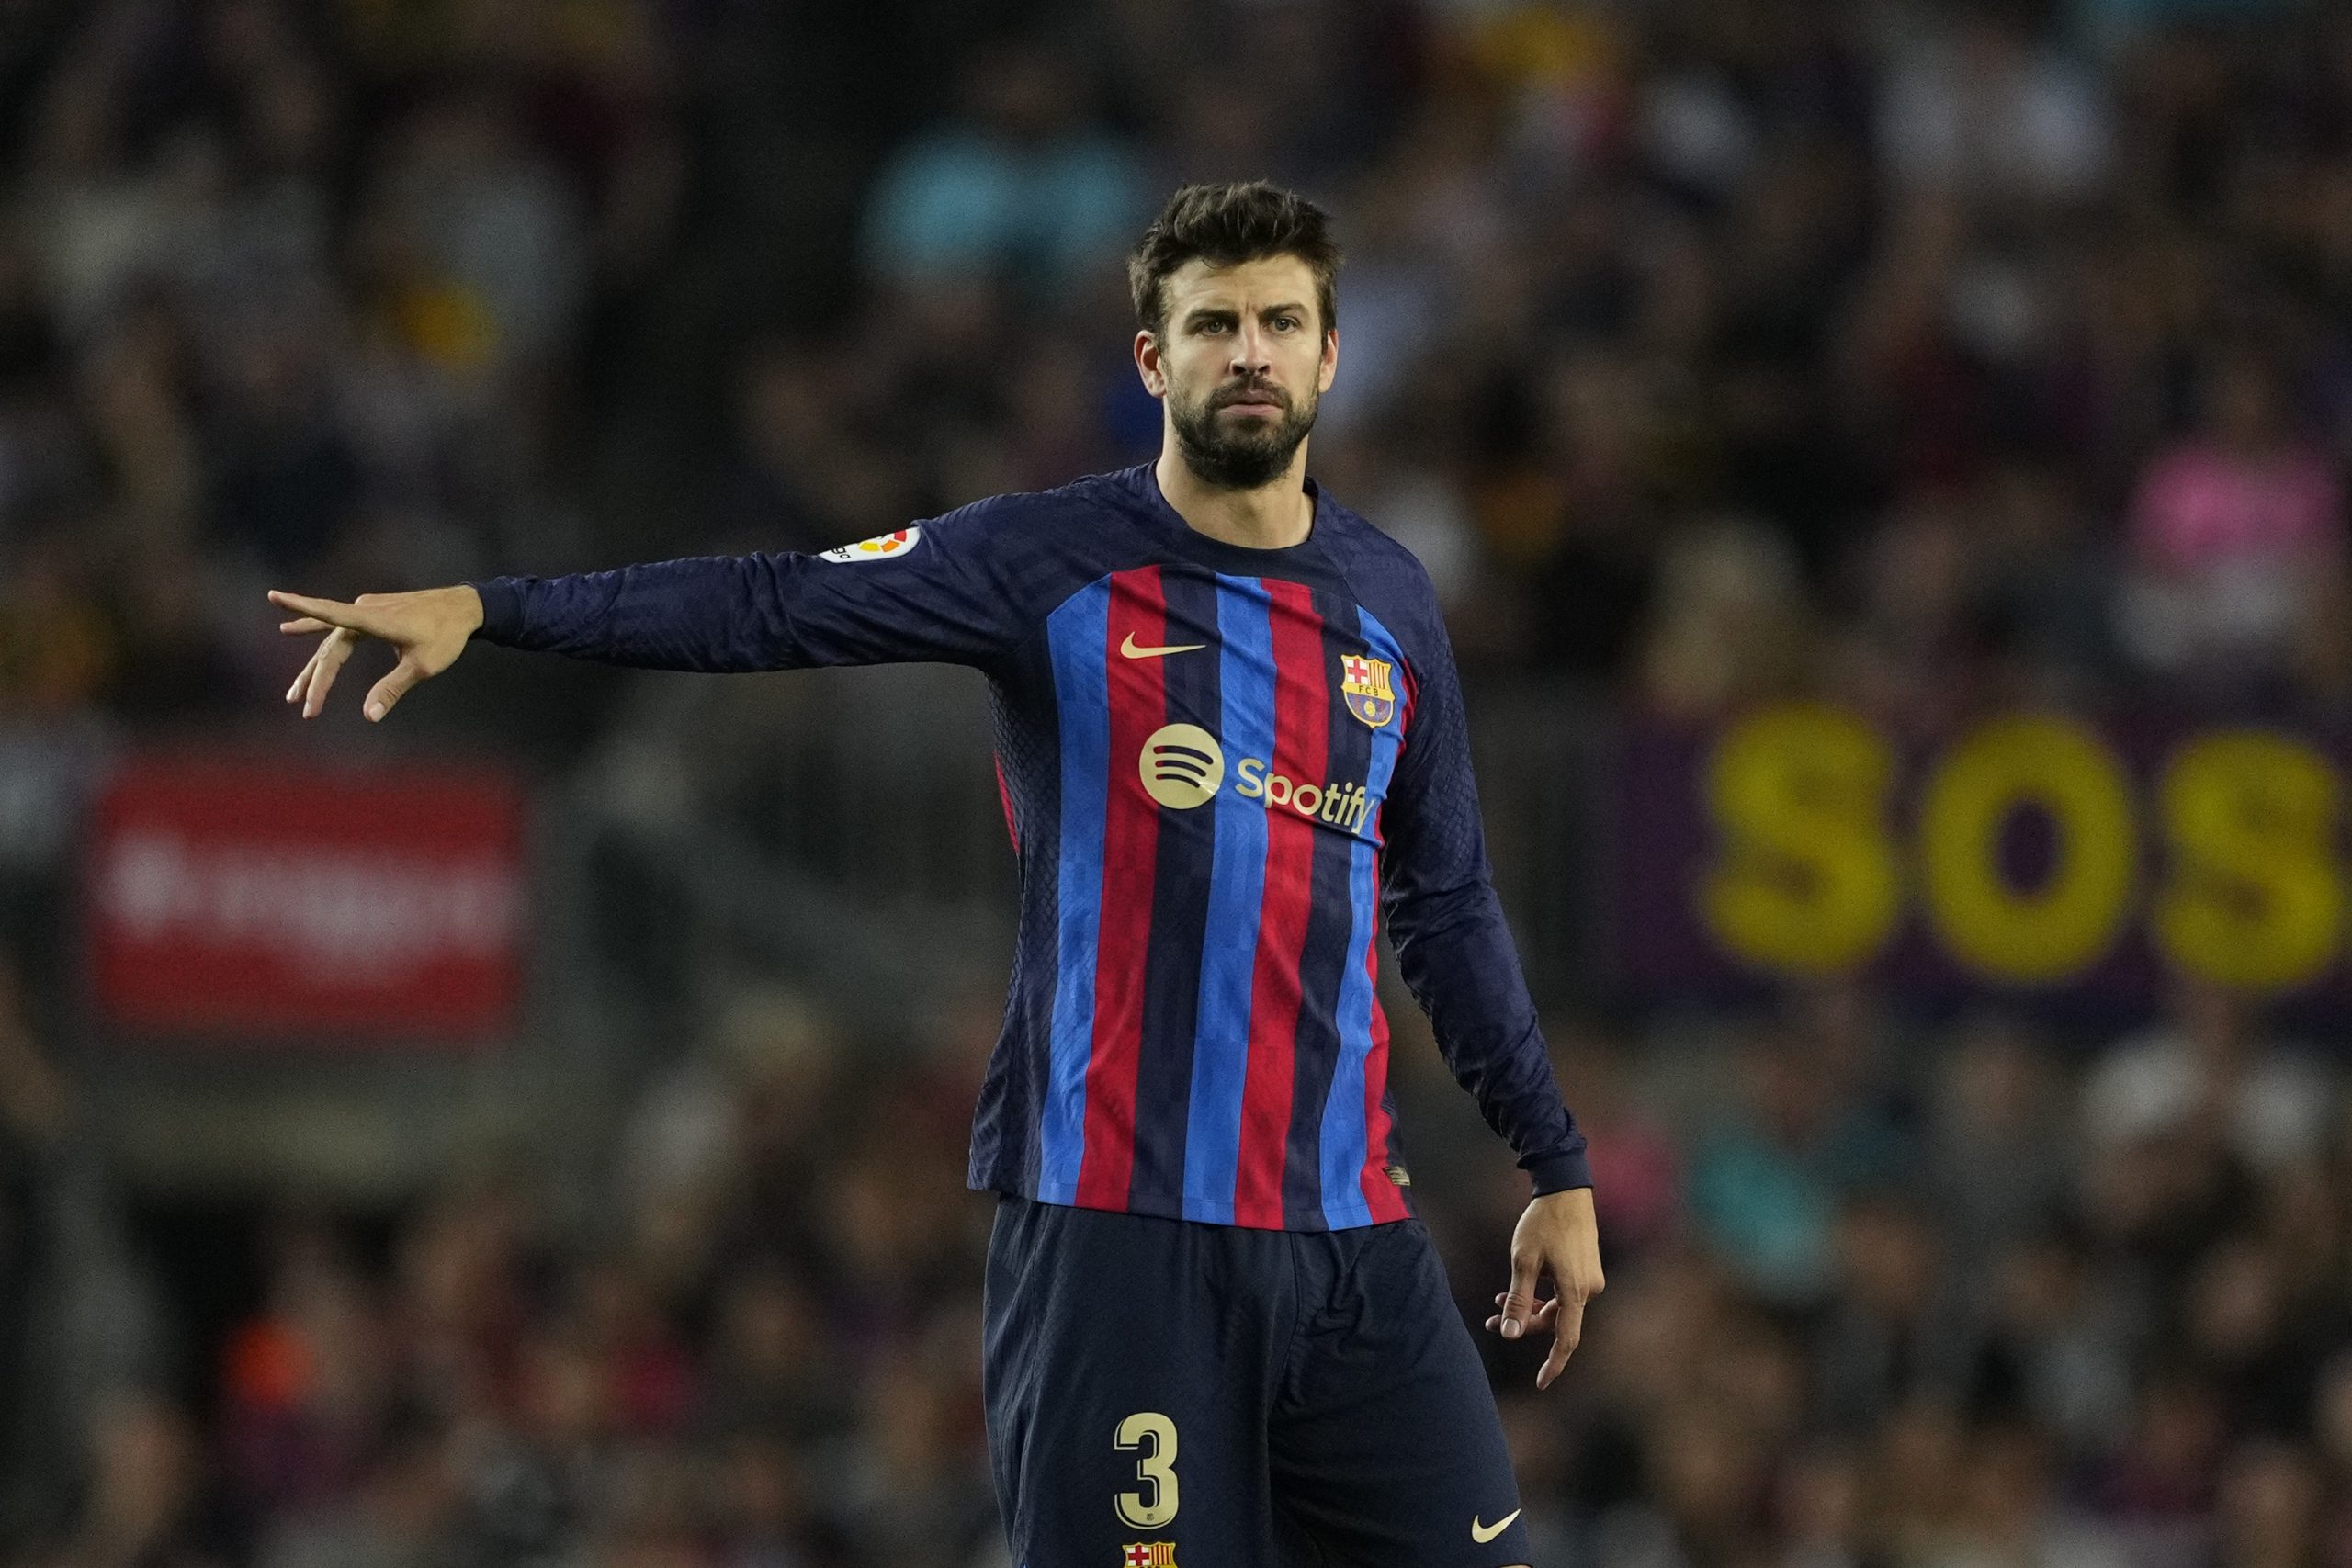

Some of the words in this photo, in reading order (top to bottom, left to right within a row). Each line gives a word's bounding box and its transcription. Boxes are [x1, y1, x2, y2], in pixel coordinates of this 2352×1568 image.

[1359, 685, 1379, 696] FCB
[1235, 758, 1375, 835] Spotify
[1702, 701, 2342, 987] SOS
[1114, 1412, 1180, 1530] 3
